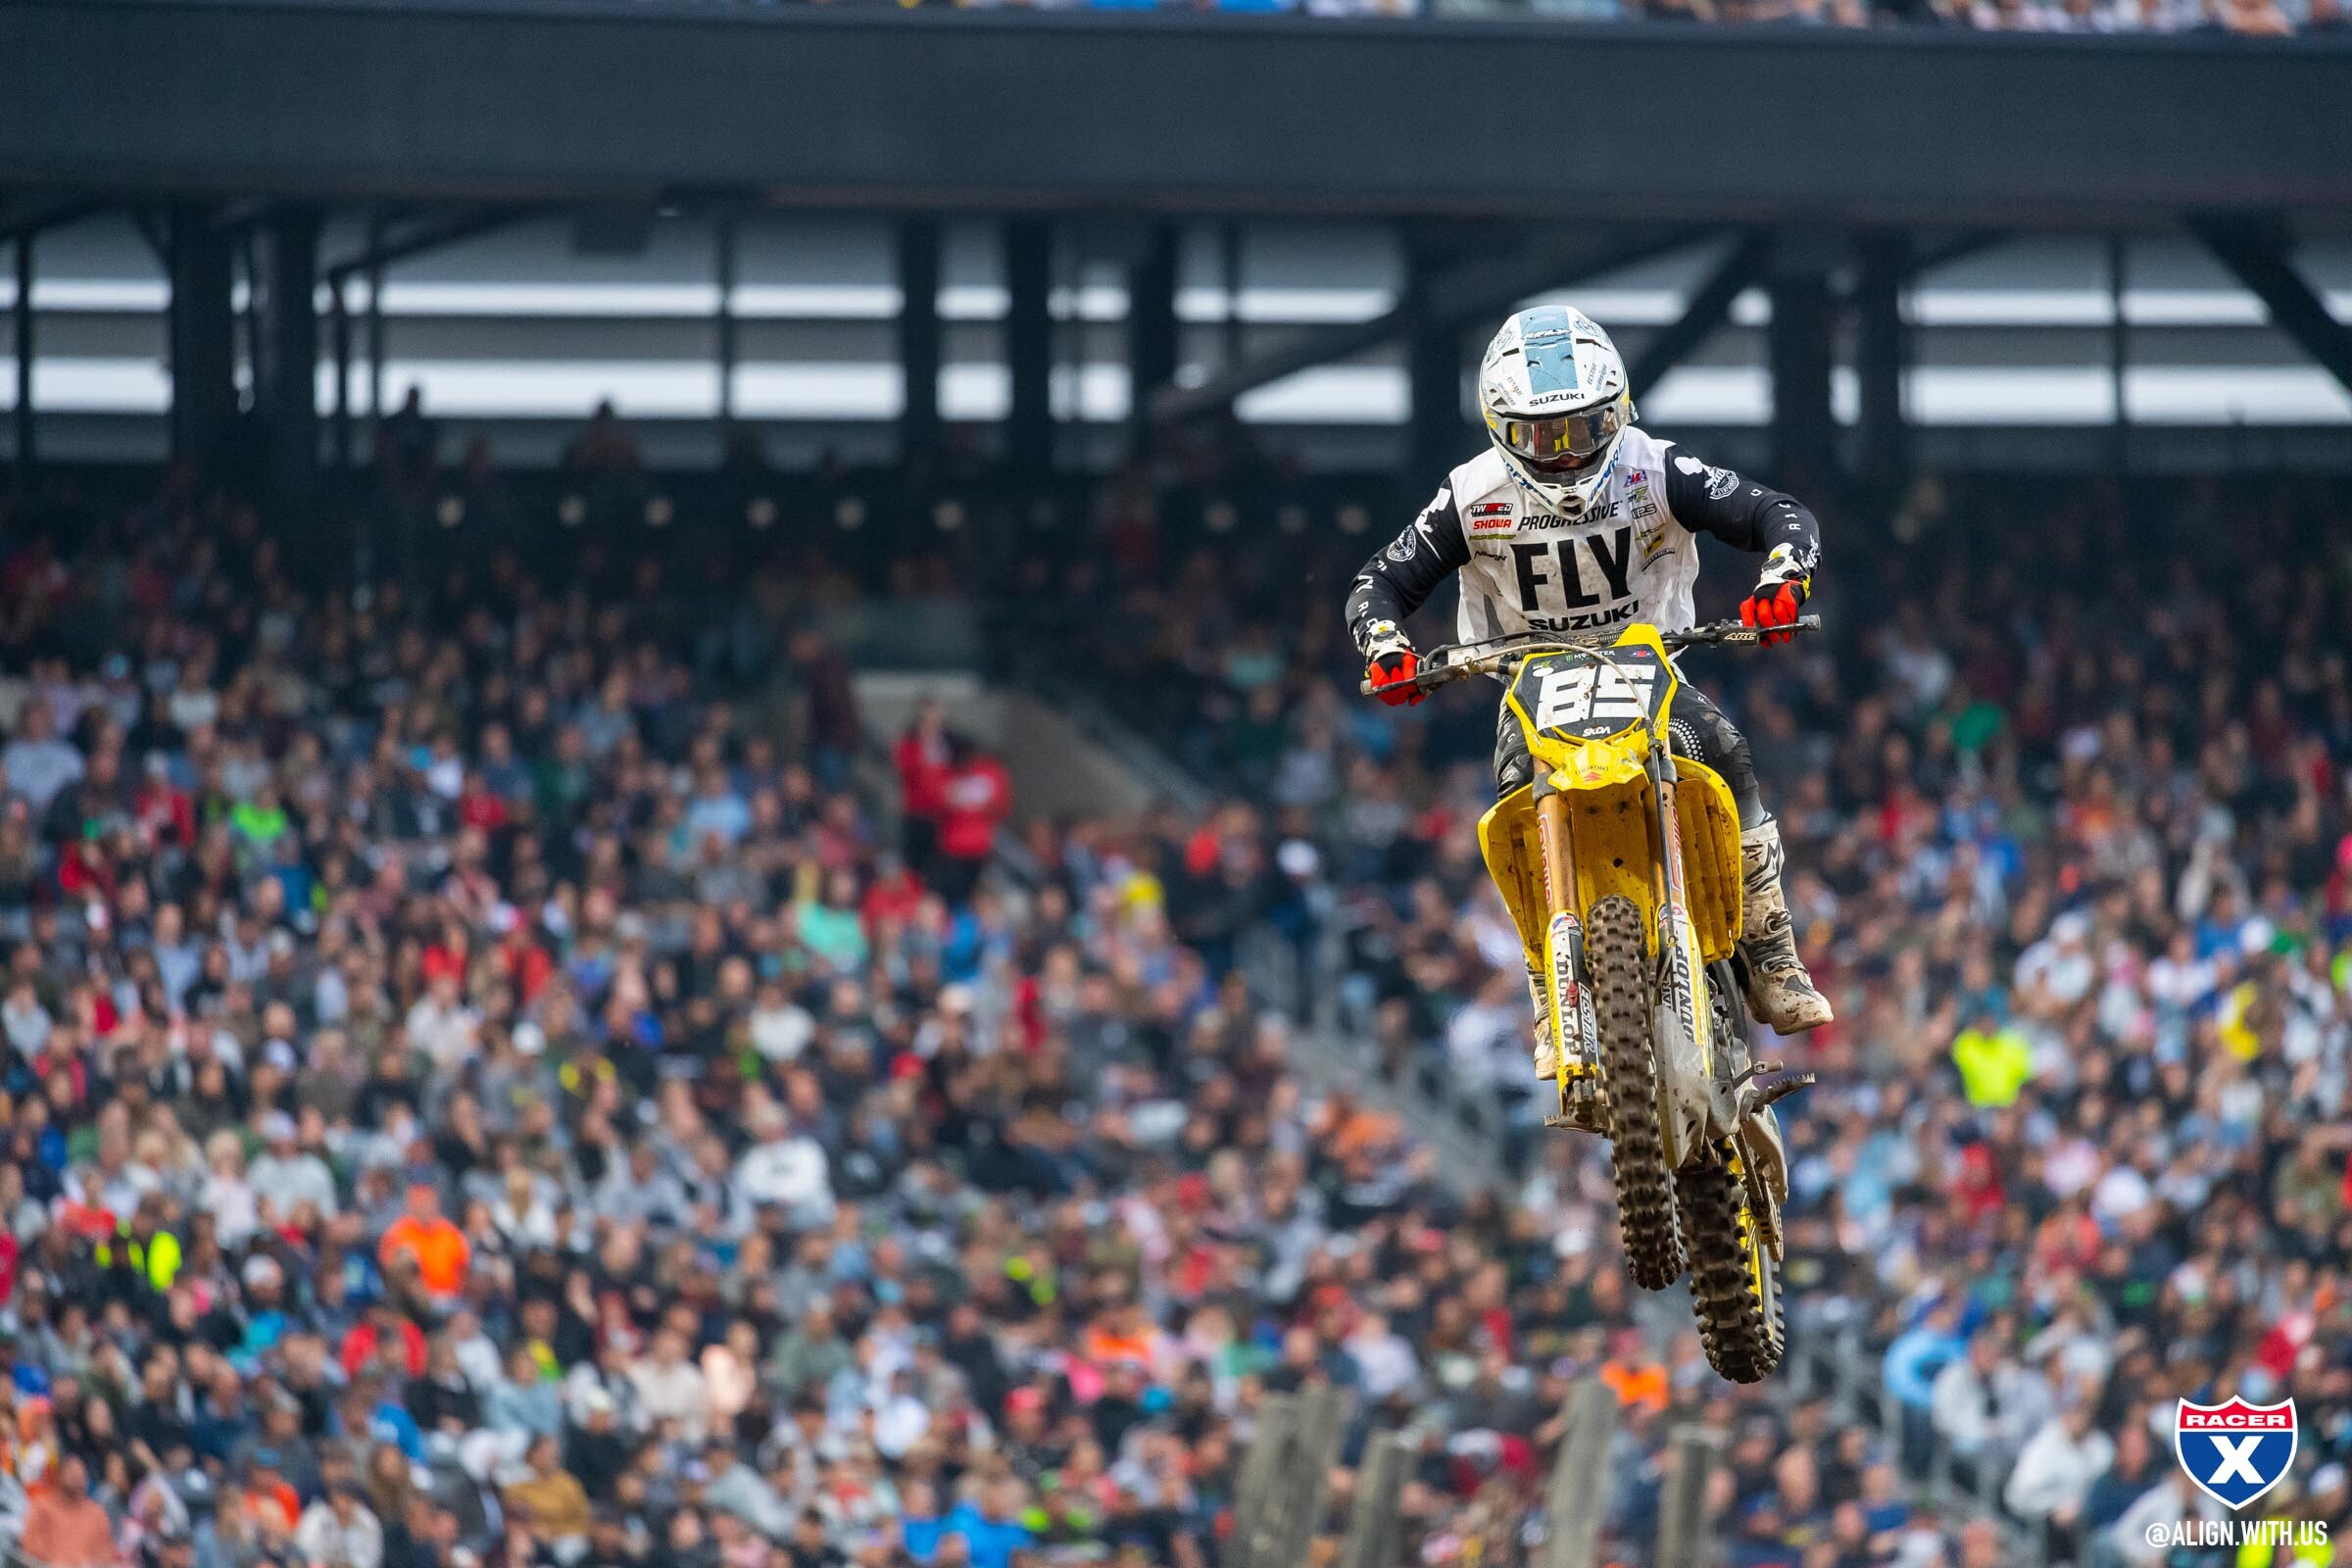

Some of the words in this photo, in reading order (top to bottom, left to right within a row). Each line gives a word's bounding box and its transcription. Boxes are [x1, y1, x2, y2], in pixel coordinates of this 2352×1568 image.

[1529, 393, 1585, 407] SUZUKI
[1473, 518, 1512, 530] SHOWA
[1510, 526, 1632, 612] FLY
[1529, 601, 1640, 632] SUZUKI
[1537, 663, 1657, 731] 85
[1555, 959, 1581, 1055] DUNLOP
[1578, 982, 1596, 1054] ECSTAR
